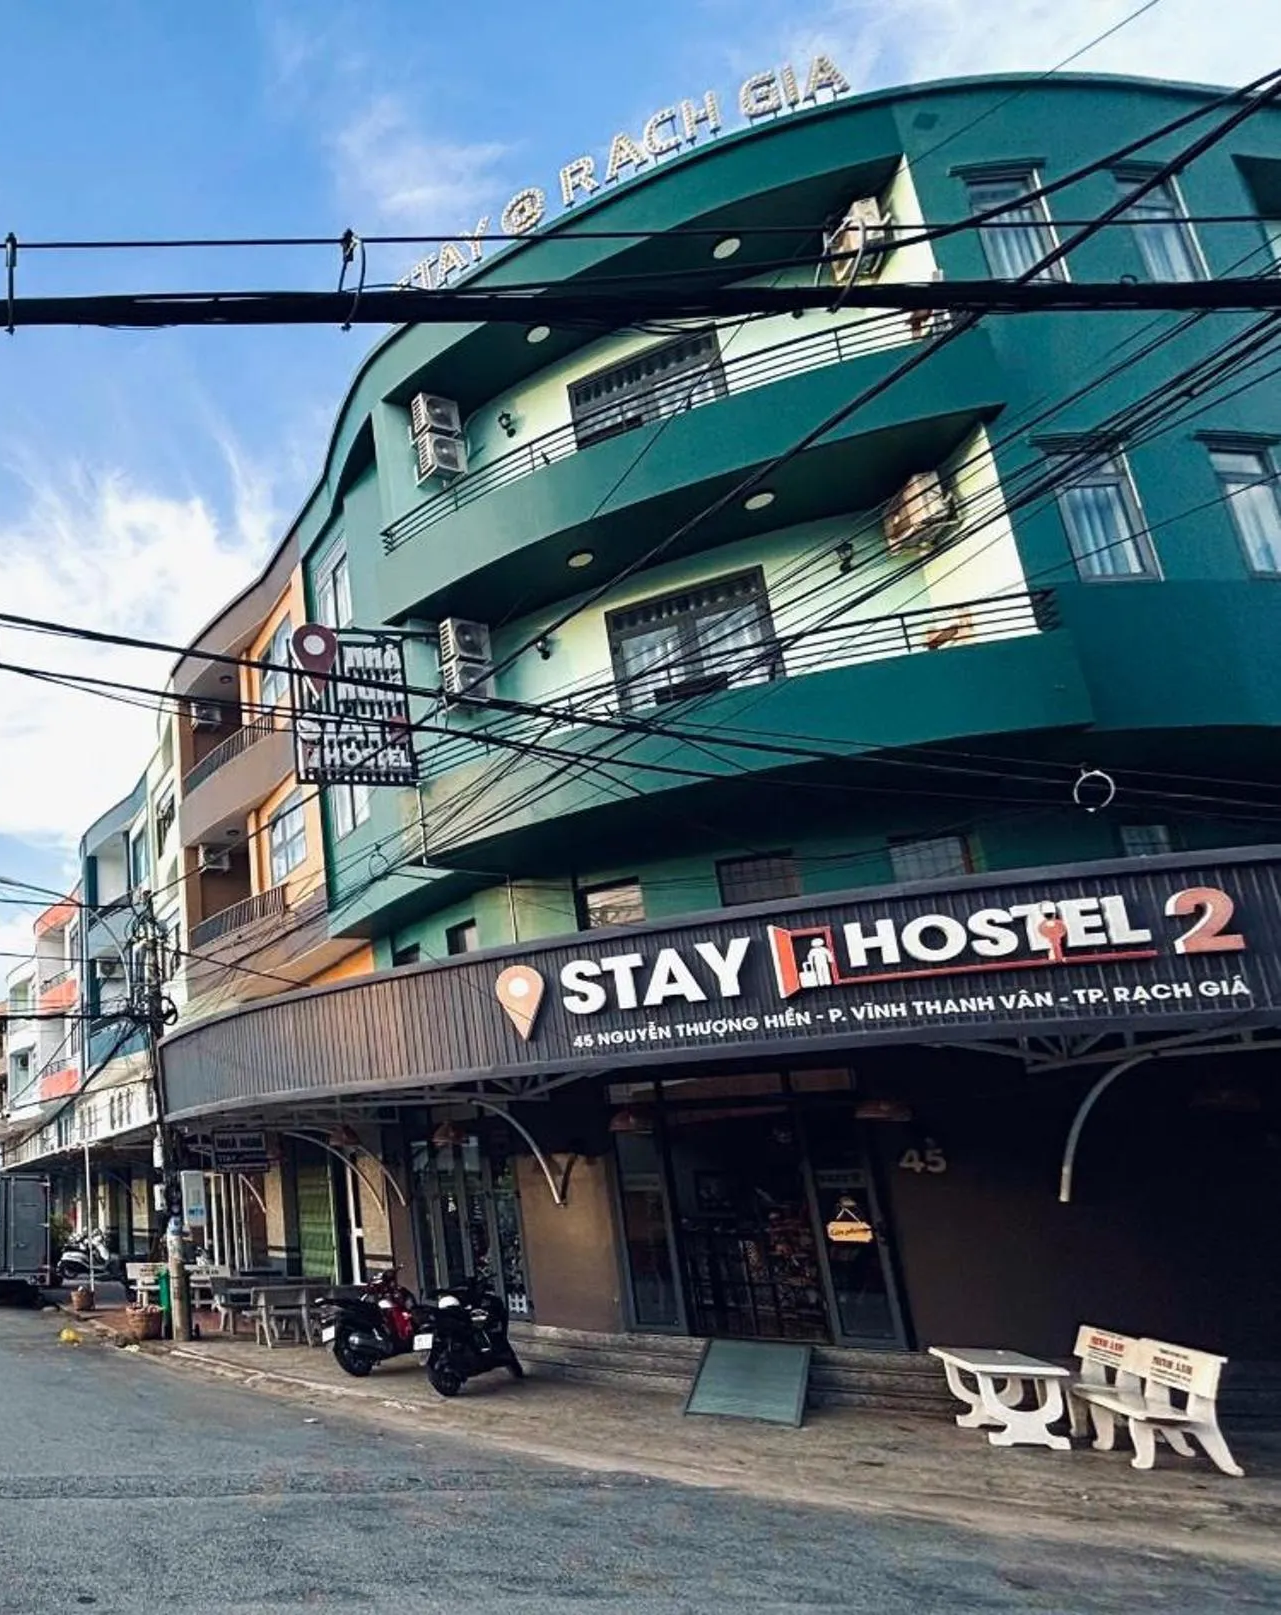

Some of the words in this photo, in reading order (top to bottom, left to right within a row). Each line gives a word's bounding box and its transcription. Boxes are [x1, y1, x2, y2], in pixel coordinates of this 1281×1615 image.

[398, 216, 490, 290] TAY
[501, 187, 545, 234] @
[558, 91, 721, 206] RACH
[738, 54, 851, 118] GIA
[560, 937, 750, 1015] STAY
[844, 895, 1152, 967] HOSTEL
[1164, 886, 1246, 954] 2
[573, 1035, 594, 1048] 45
[597, 1021, 672, 1046] NGUYỄN
[675, 1017, 758, 1037] THƯỢNG
[764, 1006, 812, 1029] HIỀN
[829, 1008, 847, 1023] P.
[912, 997, 995, 1016] THANH
[998, 989, 1054, 1010] VÂN
[1072, 989, 1108, 1005] TP.
[1113, 982, 1193, 1005] RẠCH
[899, 1149, 947, 1173] 45
